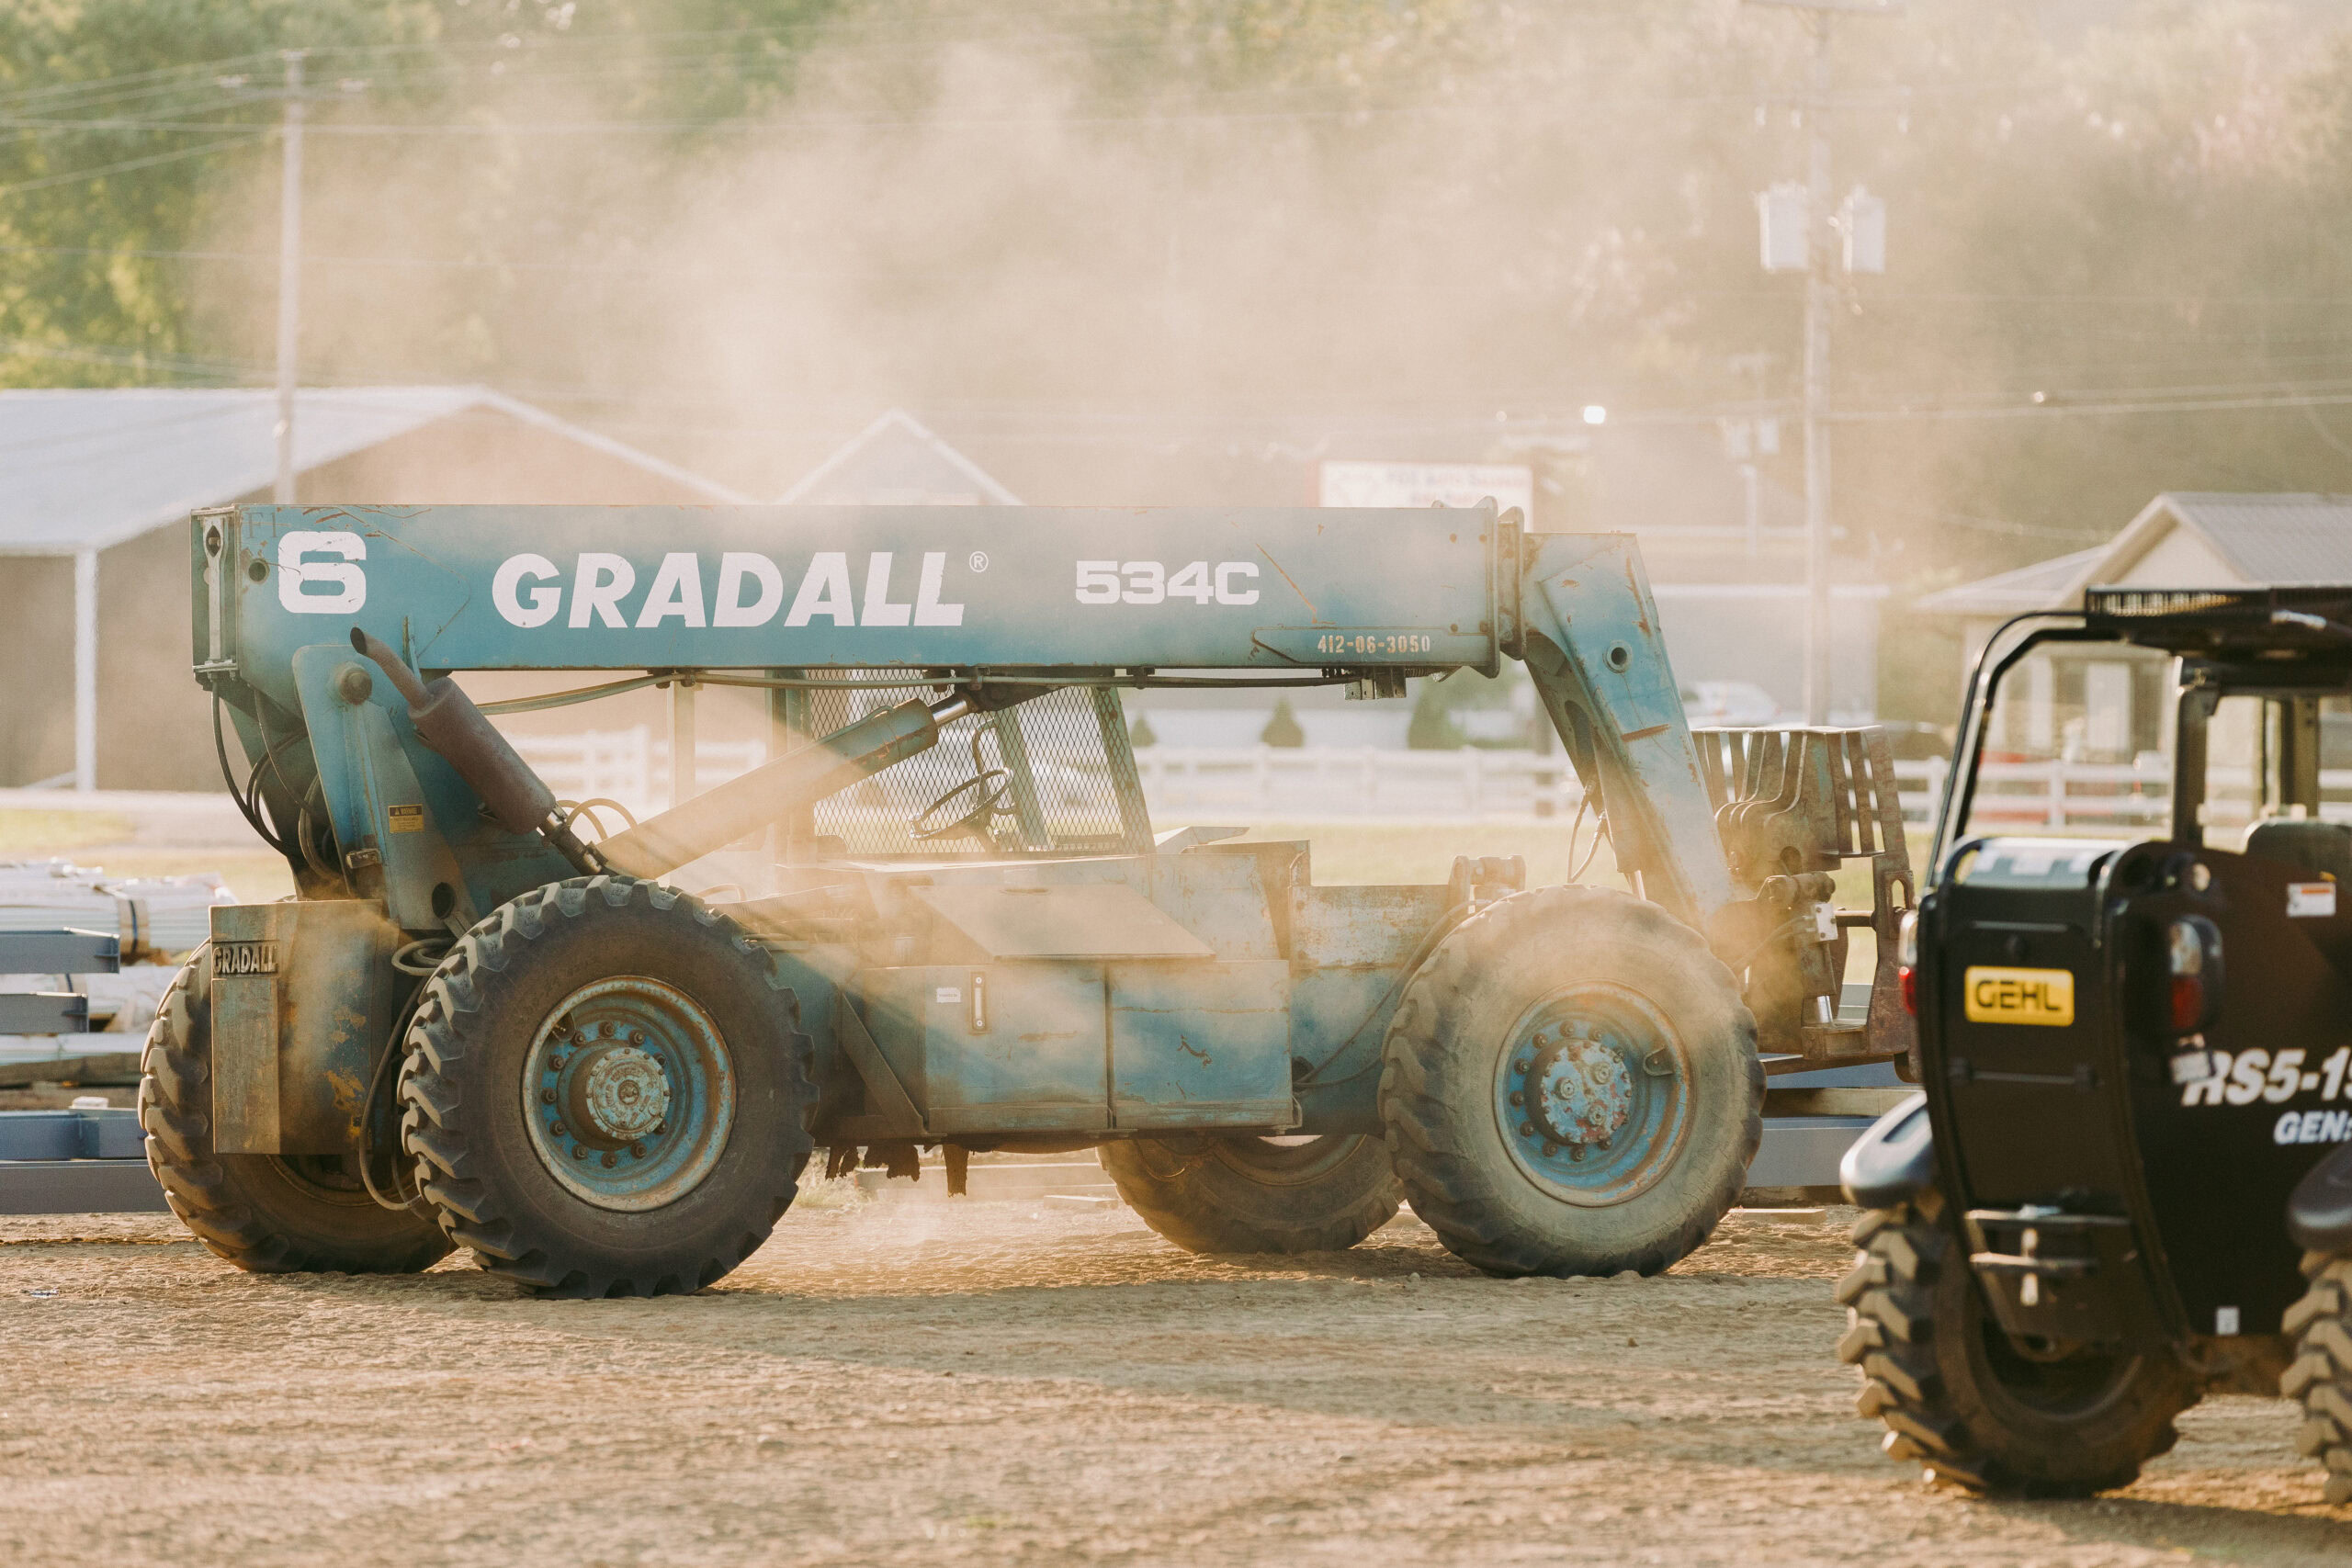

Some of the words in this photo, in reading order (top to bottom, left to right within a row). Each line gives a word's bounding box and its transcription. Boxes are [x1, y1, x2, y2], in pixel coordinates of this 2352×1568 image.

[277, 530, 367, 615] 6
[492, 551, 965, 628] GRADALL
[1076, 559, 1260, 605] 534C
[1317, 634, 1431, 654] 412-06-3050
[212, 946, 279, 974] GRADALL
[1975, 979, 2061, 1011] GEHL
